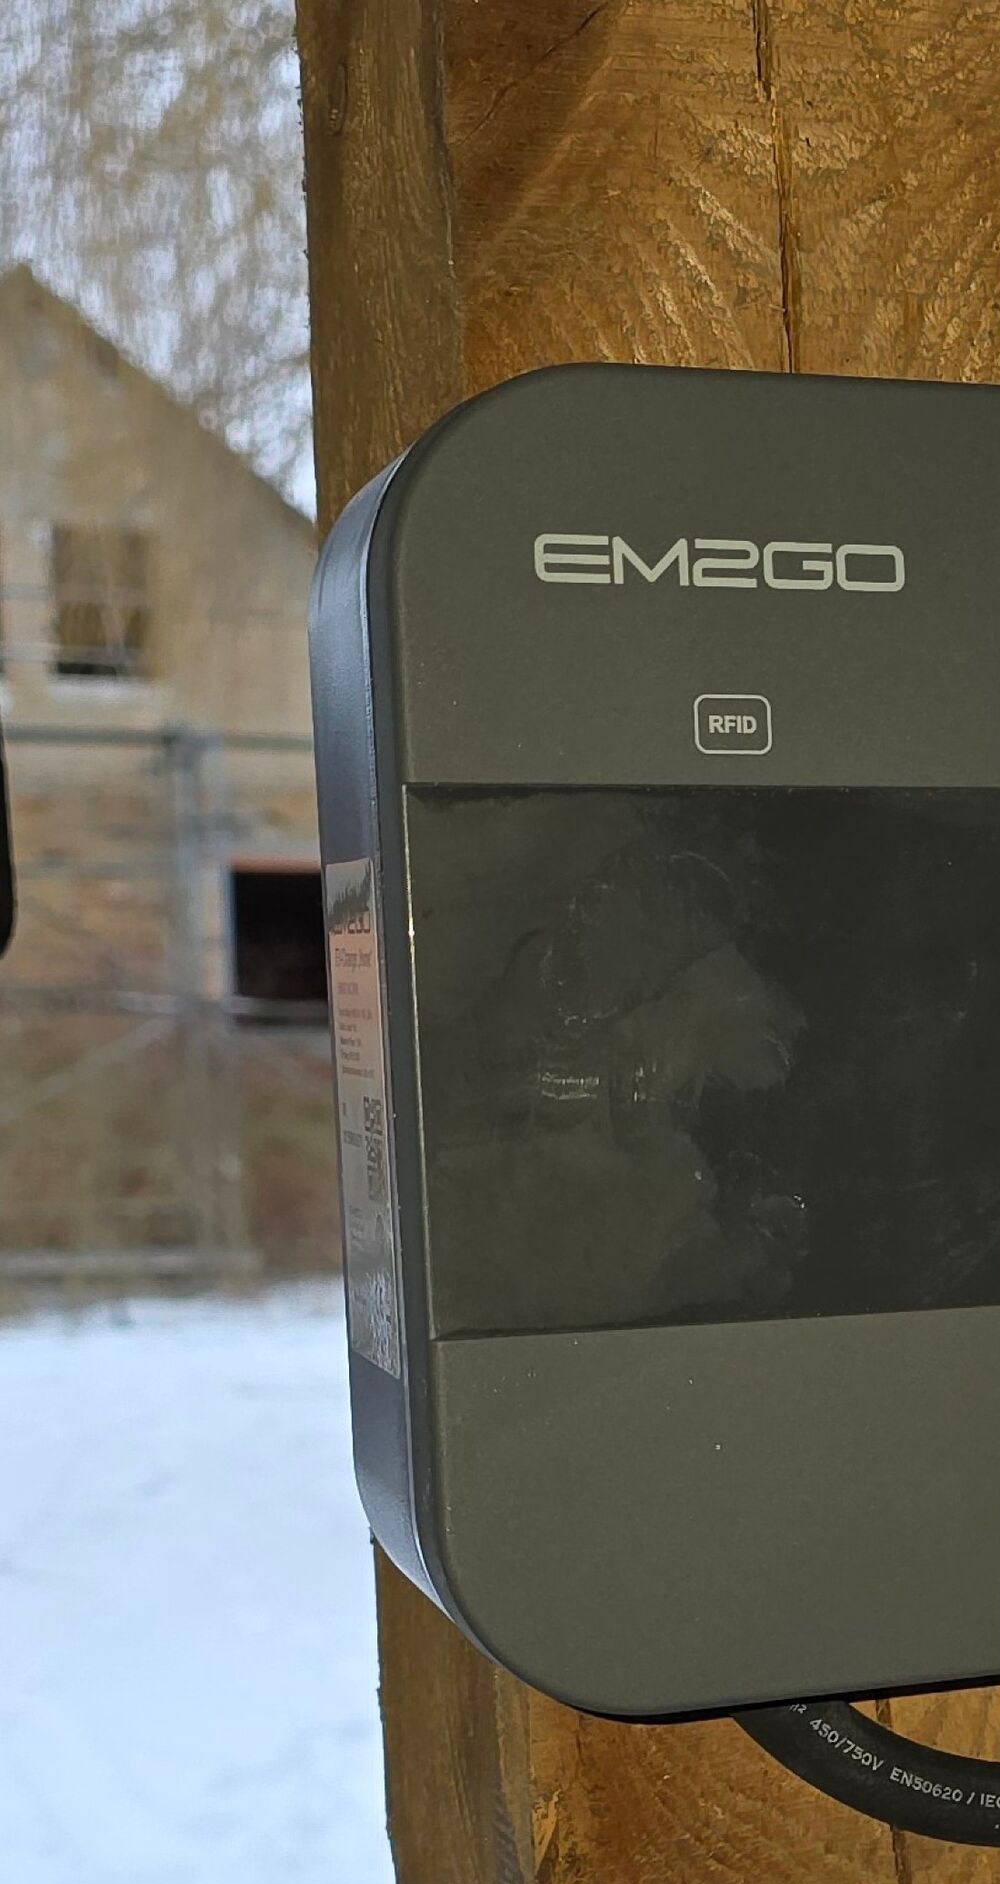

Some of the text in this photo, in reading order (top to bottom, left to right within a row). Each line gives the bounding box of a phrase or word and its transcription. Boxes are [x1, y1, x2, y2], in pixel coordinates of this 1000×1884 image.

[534, 533, 905, 592] EM2GO
[708, 715, 757, 734] RFID
[809, 1718, 885, 1771] 450/750V
[889, 1766, 964, 1802] EN50620
